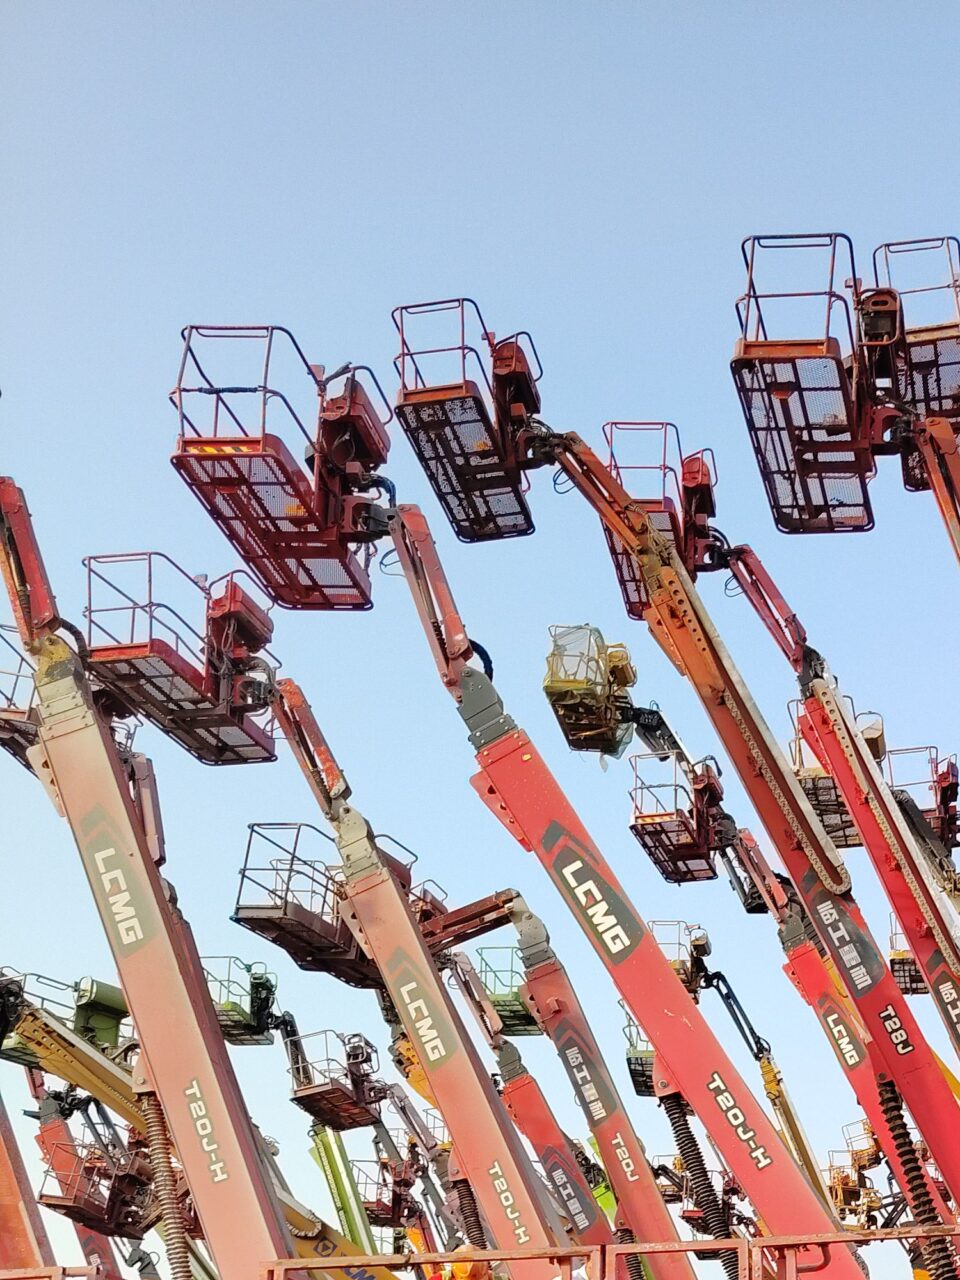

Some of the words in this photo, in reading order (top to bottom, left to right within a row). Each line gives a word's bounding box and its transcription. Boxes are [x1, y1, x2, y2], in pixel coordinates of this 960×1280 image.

[878, 1003, 914, 1055] T28J
[185, 1080, 228, 1182] T20J-H
[611, 1132, 640, 1182] T20J
[707, 1071, 773, 1170] T20J-H
[489, 1161, 530, 1244] T20J-H
